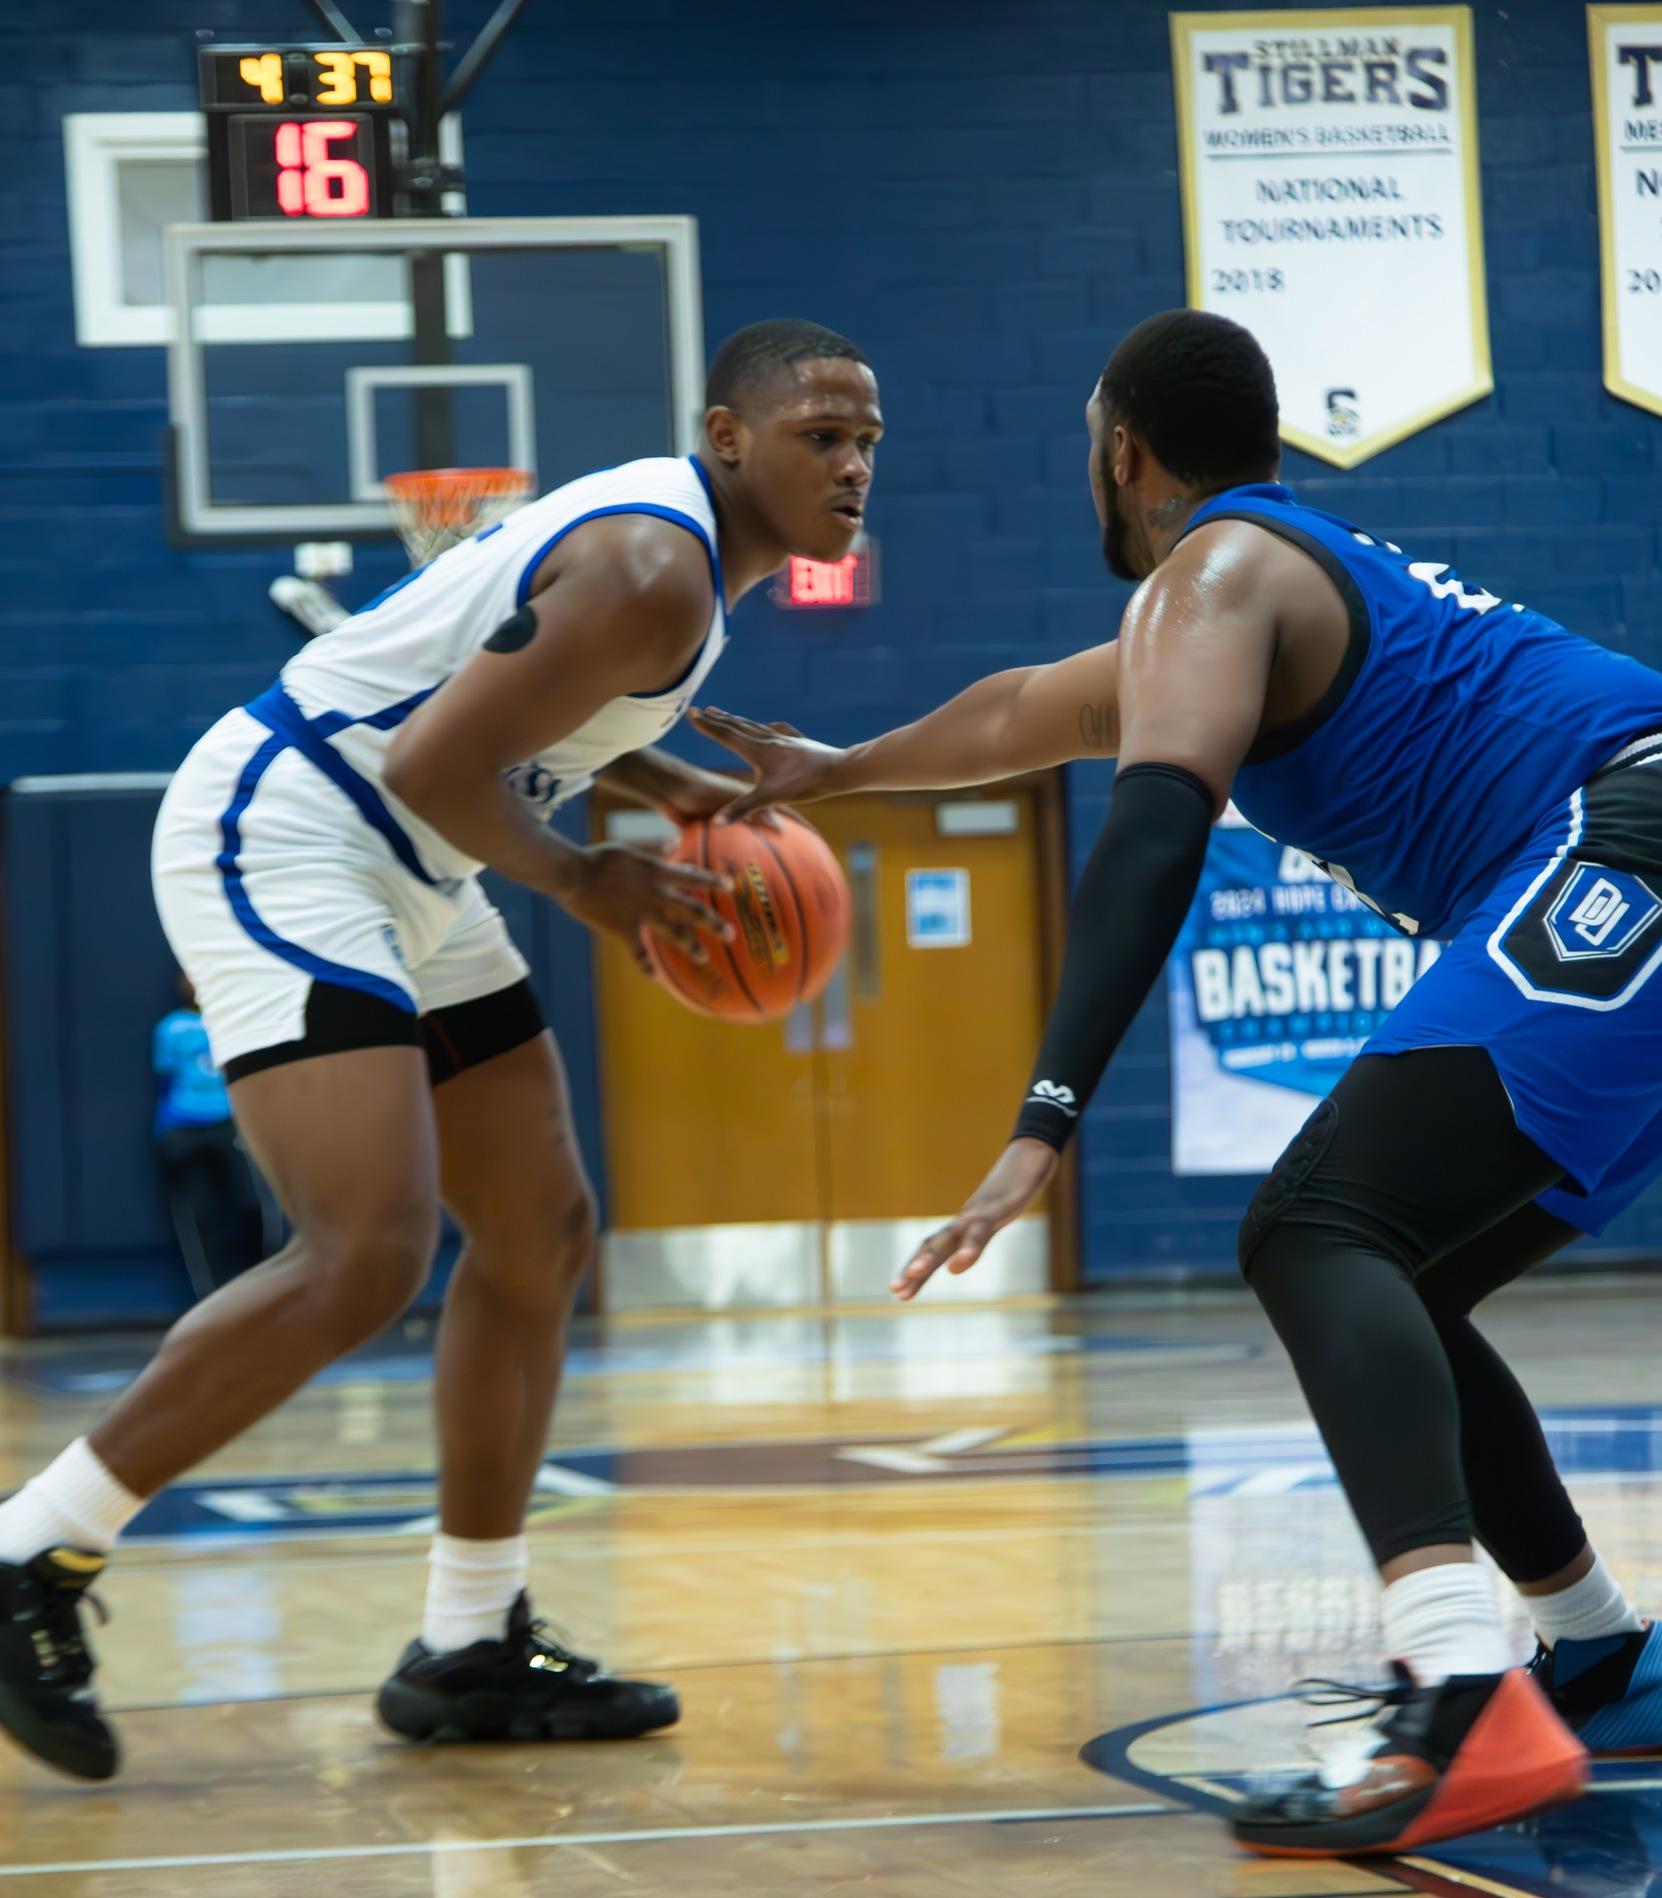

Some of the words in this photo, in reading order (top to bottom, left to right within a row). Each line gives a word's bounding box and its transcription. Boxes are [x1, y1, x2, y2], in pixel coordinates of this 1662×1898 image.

[1254, 36, 1399, 60] STILLMAN
[240, 53, 284, 105] 4
[313, 51, 393, 105] 37
[1203, 47, 1448, 115] TIGERS
[1203, 126, 1309, 148] WOMEN'S
[1314, 123, 1452, 146] BASKETBALL
[1624, 119, 1662, 141] ME
[275, 121, 369, 217] 16
[1635, 168, 1662, 196] N
[1256, 176, 1404, 203] NATIONAL
[1220, 214, 1446, 243] TOURNAMENTS
[1211, 267, 1285, 293] 2018
